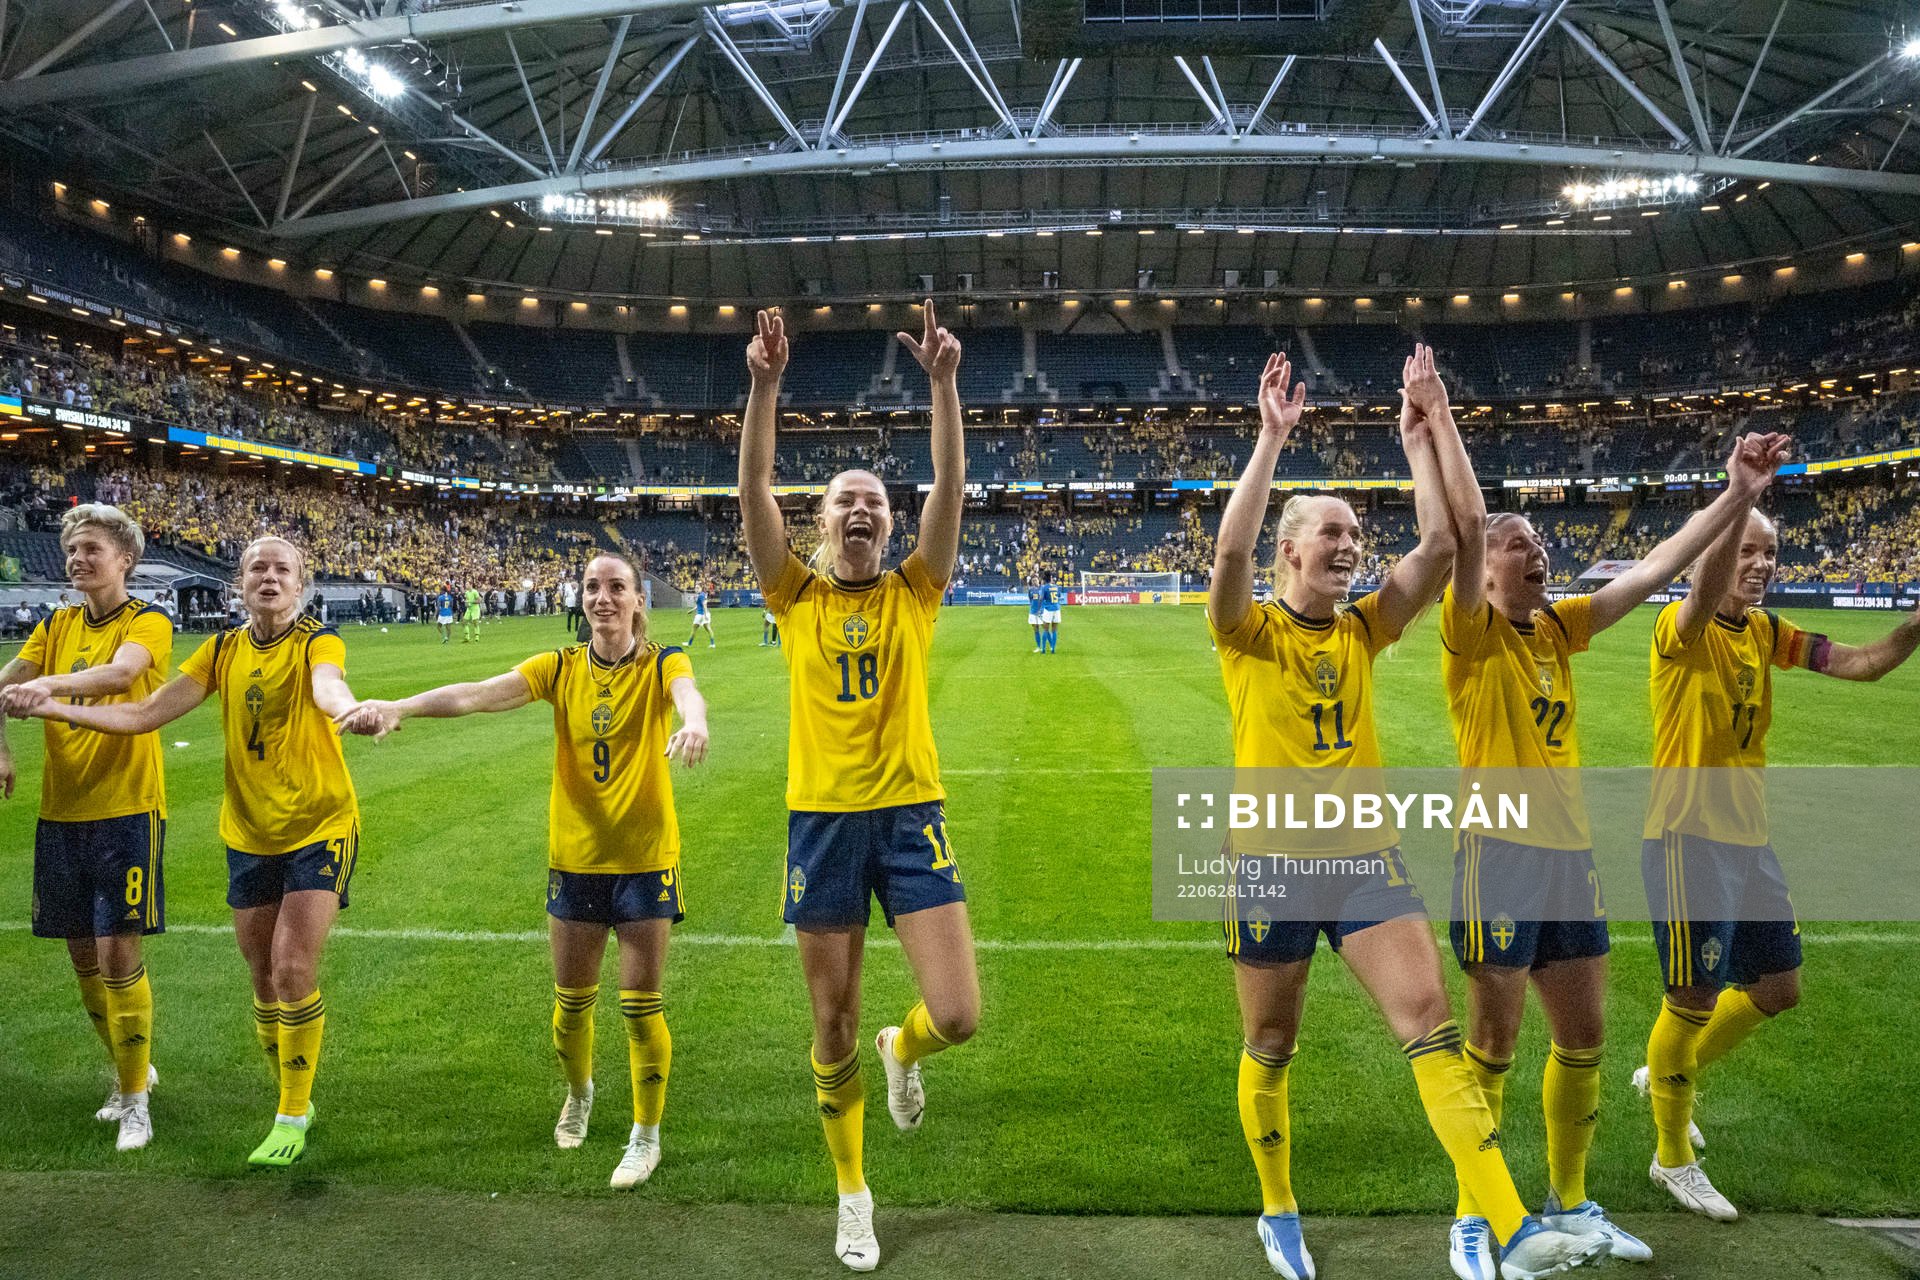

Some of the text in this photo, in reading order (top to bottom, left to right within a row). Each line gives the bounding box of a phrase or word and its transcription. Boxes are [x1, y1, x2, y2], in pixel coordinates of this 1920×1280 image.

[85, 413, 98, 427] 123
[500, 482, 512, 490] SWE
[552, 484, 573, 493] 90:00
[1601, 477, 1619, 485] SWE
[1664, 474, 1688, 482] 90:00
[1050, 592, 1058, 603] 15
[836, 652, 879, 702] 18
[248, 720, 264, 760] 4
[1311, 700, 1352, 750] 11
[1530, 696, 1566, 747] 22
[593, 740, 610, 783] 9
[326, 840, 341, 862] 4
[125, 866, 143, 906] 8
